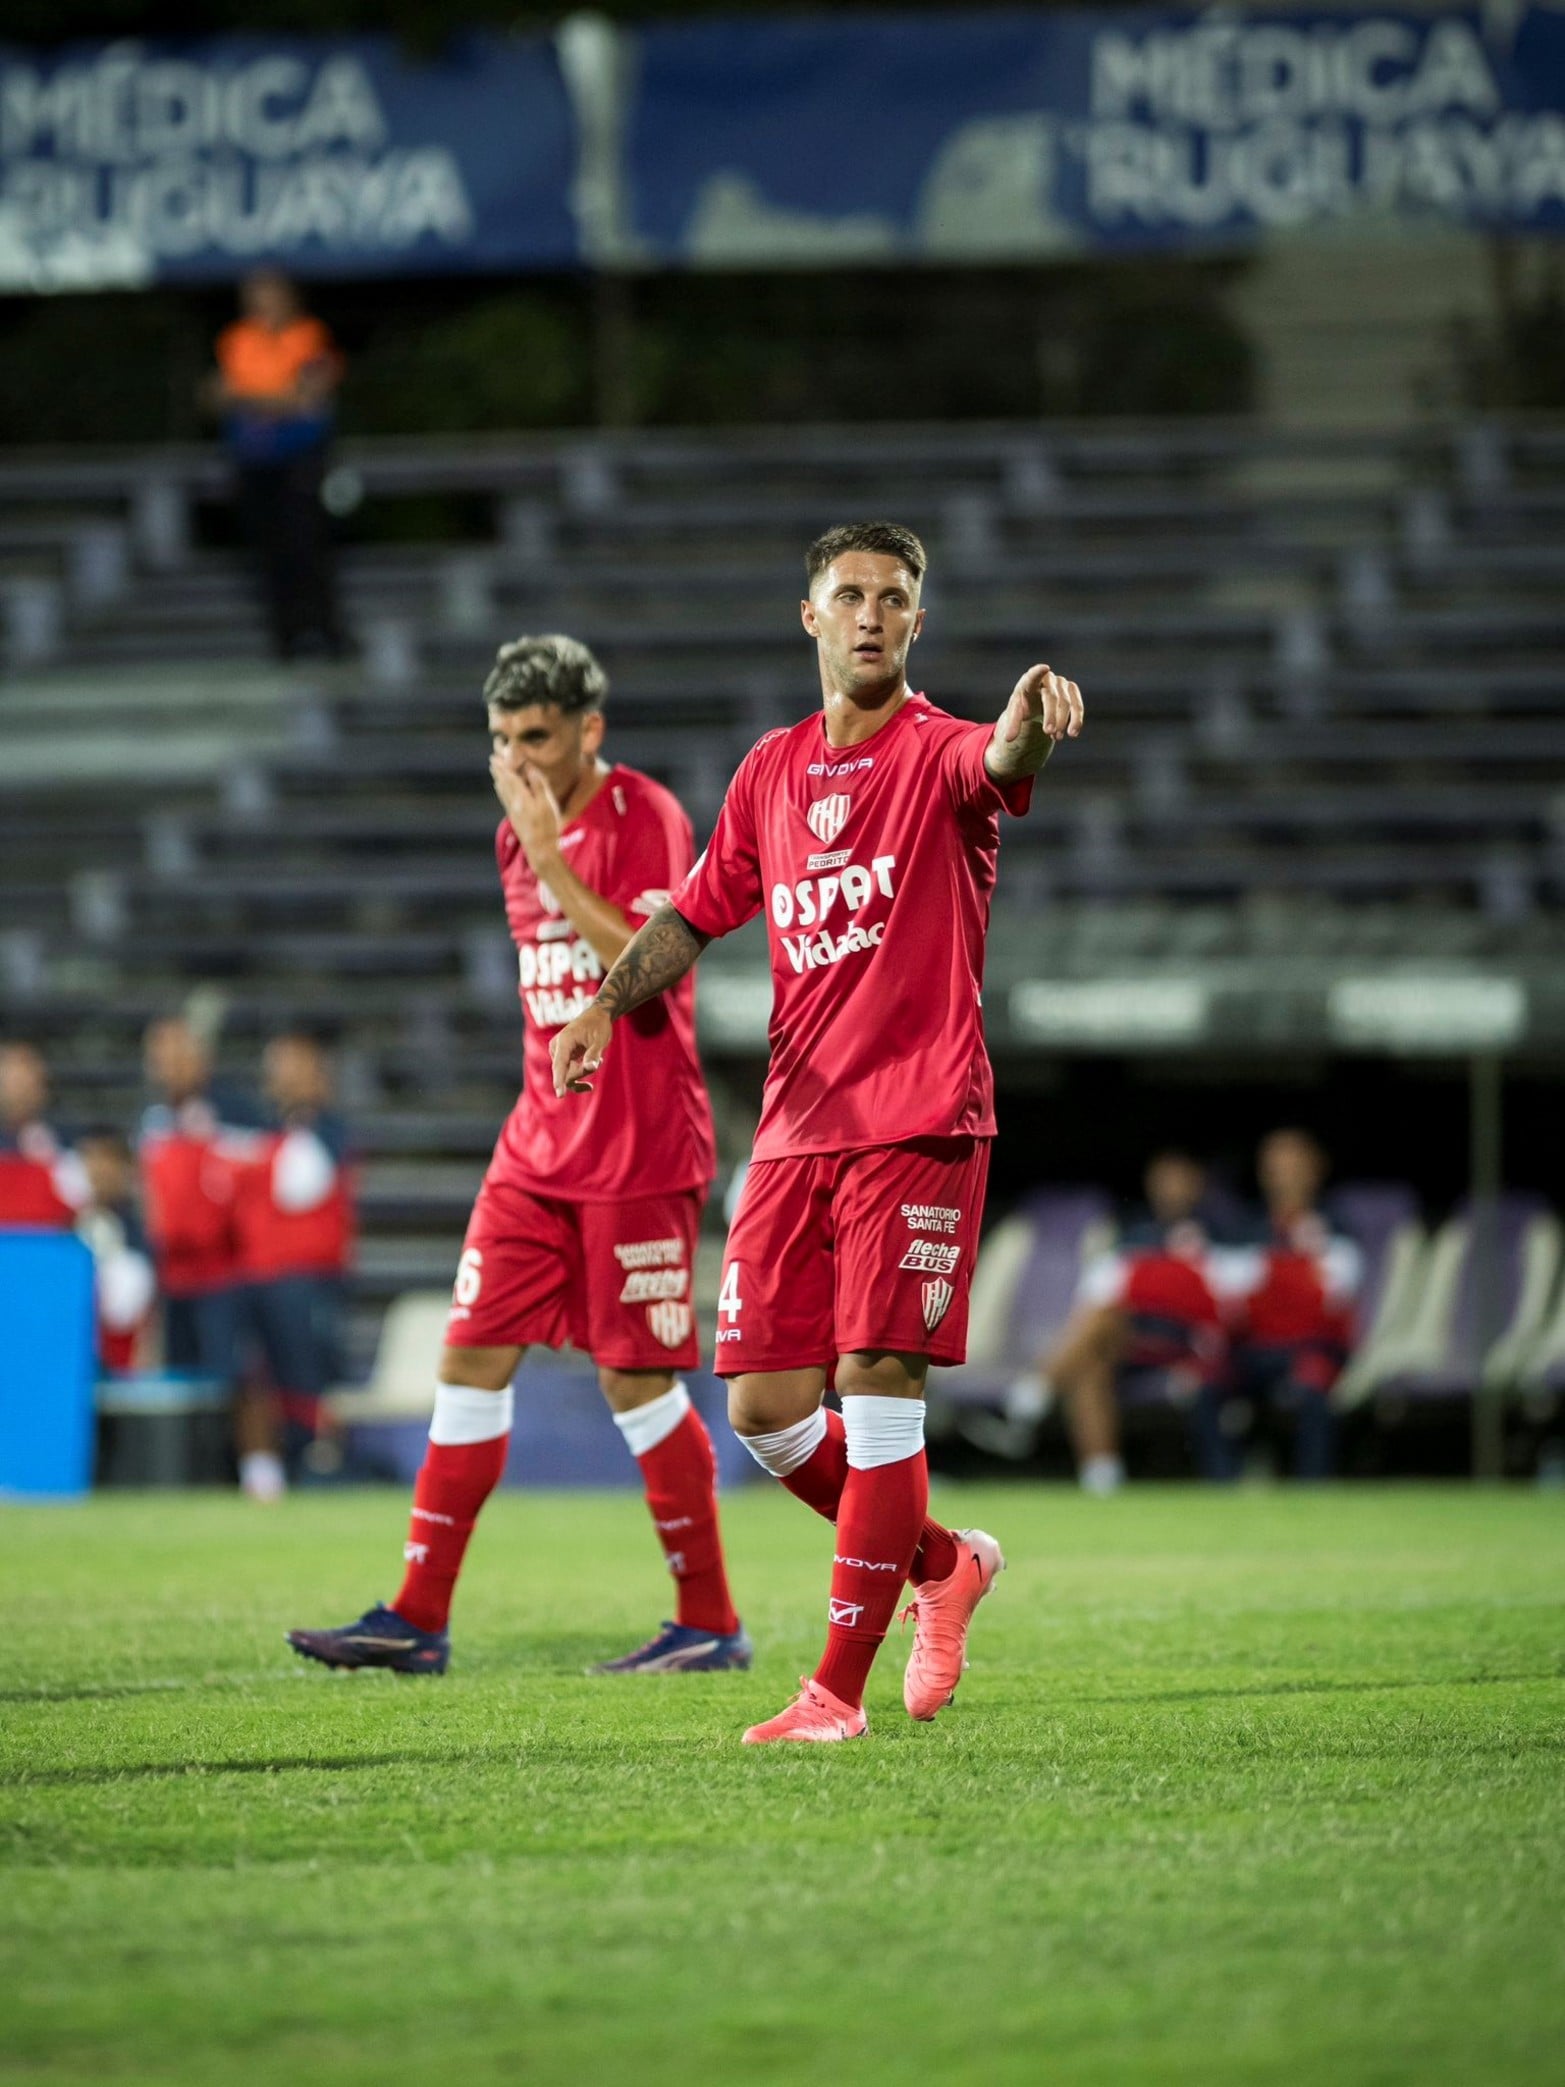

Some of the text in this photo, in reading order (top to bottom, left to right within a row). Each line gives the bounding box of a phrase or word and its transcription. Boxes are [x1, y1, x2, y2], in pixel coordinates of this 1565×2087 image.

[806, 757, 874, 778] GIVOVA
[771, 855, 896, 929] OSPAT
[519, 938, 601, 988] OSPA
[900, 1204, 961, 1222] SANATORIO
[907, 1217, 956, 1234] SANTA FE
[908, 1239, 961, 1259] flecha
[902, 1256, 953, 1271] BUS
[718, 1261, 743, 1324] 4
[833, 1553, 898, 1573] IVOVA
